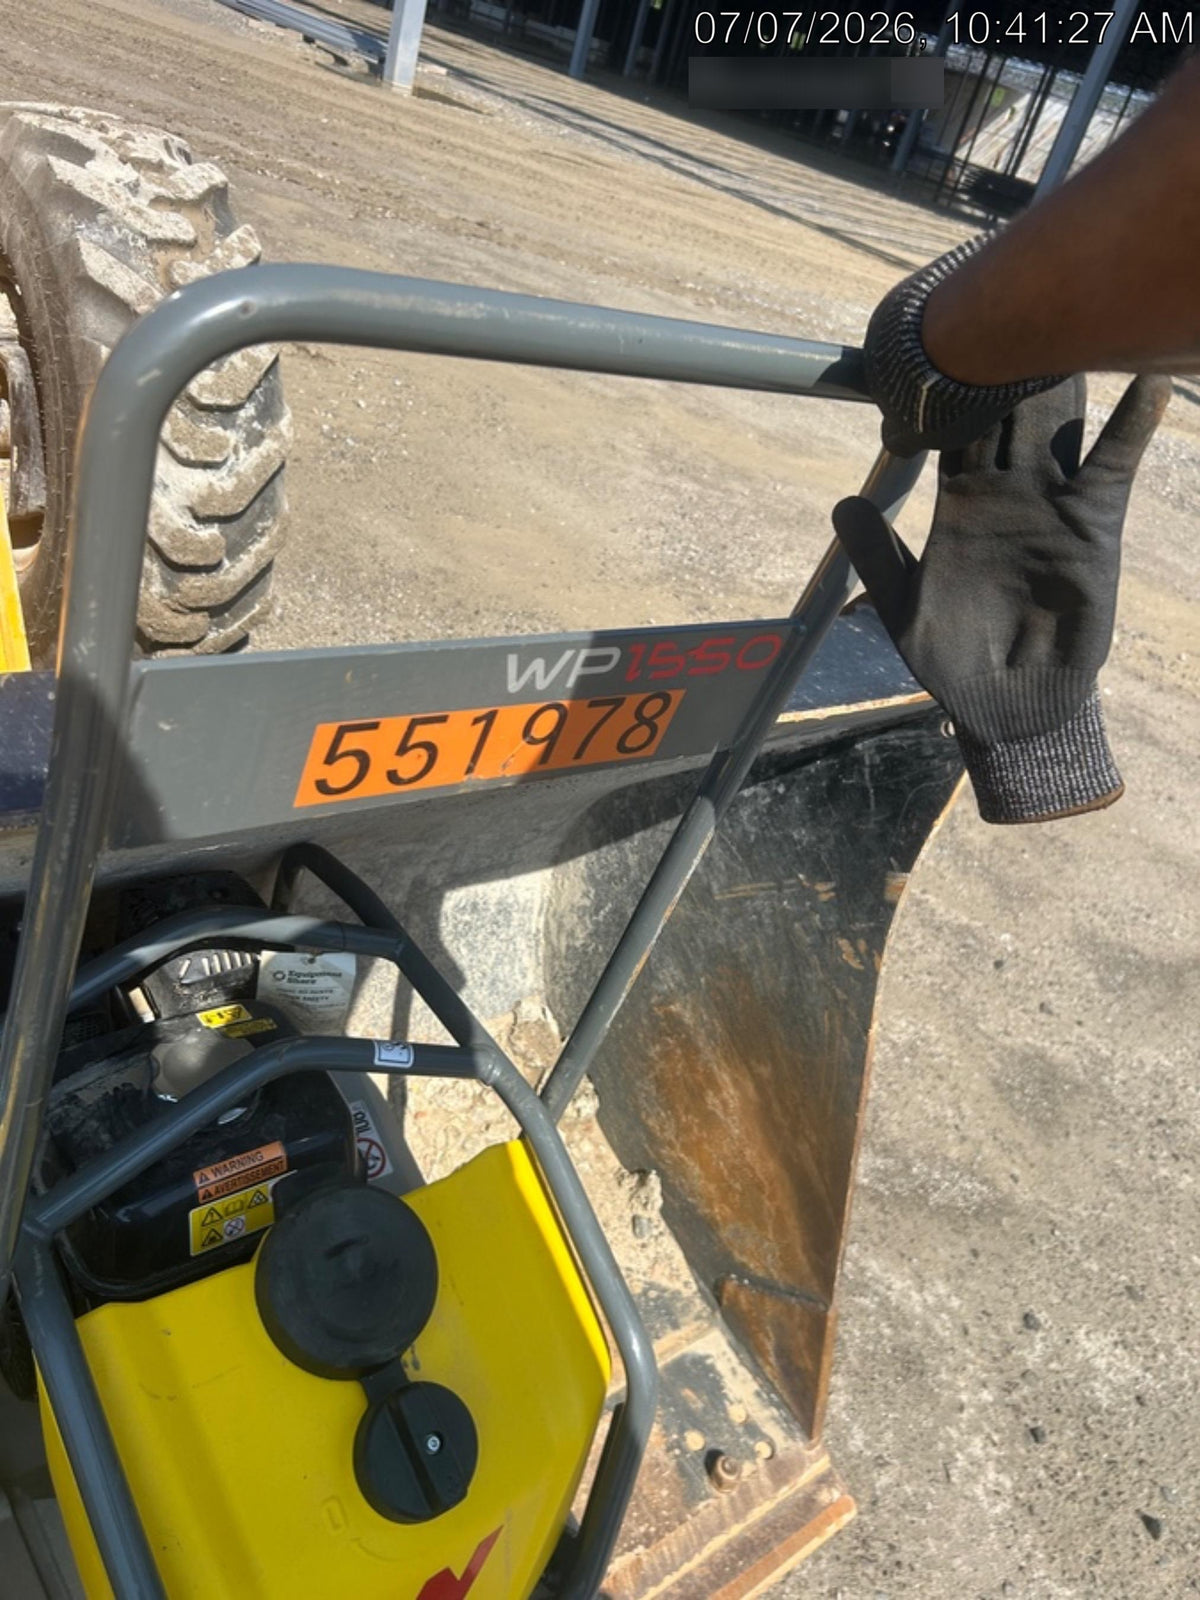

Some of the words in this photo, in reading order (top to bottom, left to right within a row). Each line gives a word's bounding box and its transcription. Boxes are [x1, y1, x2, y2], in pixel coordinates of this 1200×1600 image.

[314, 691, 673, 796] 551978
[211, 1150, 264, 1178] WARNING
[214, 1160, 285, 1196] AVERTISSEMENT
